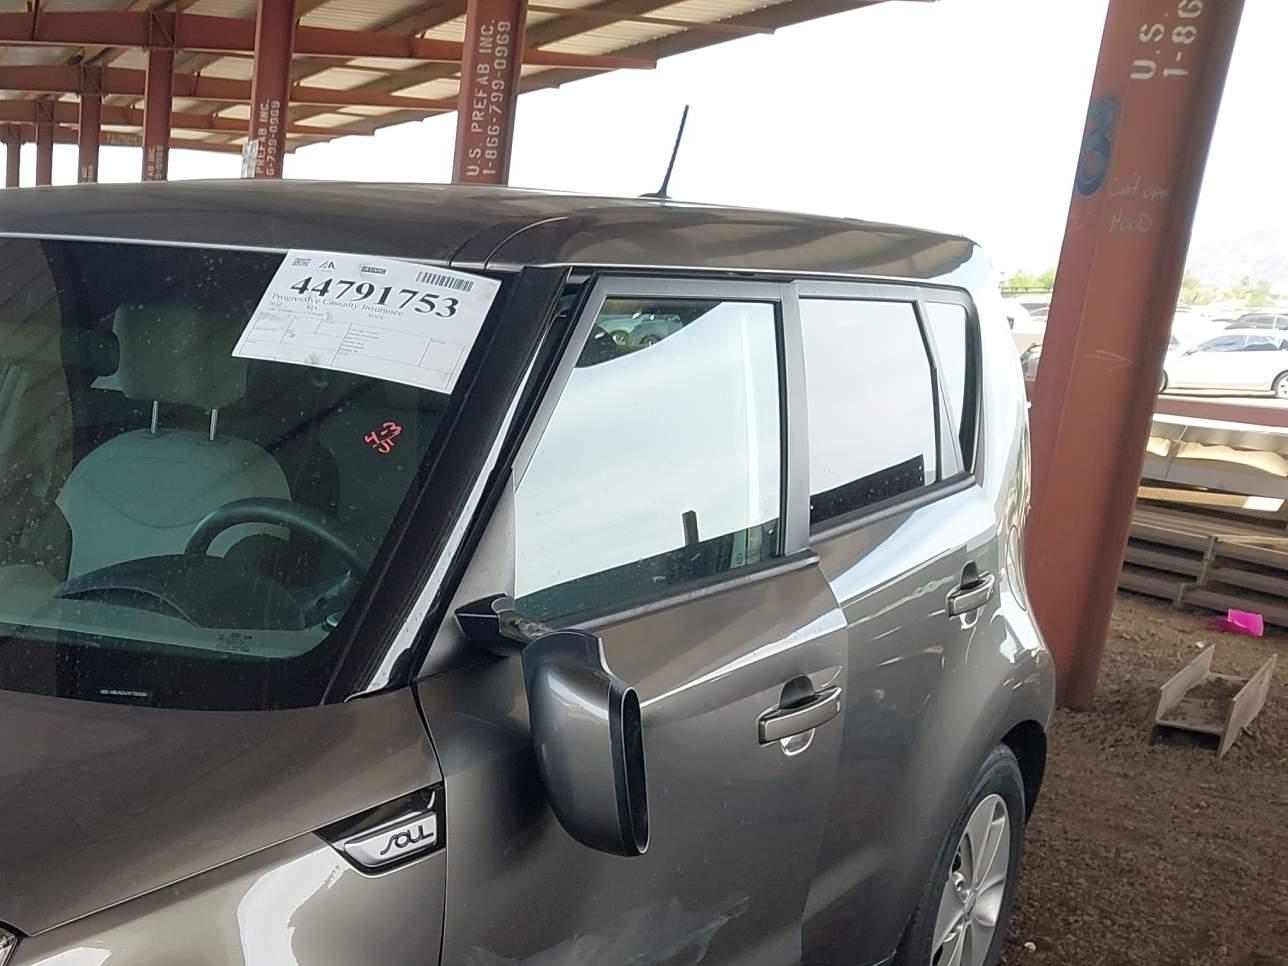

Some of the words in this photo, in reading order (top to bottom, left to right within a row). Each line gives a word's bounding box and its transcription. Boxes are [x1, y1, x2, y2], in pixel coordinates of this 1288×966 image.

[479, 19, 495, 53] INC.
[471, 63, 490, 132] PREFAB
[483, 21, 511, 175] 1-866-799-0969
[272, 293, 321, 305] Progressive
[322, 299, 357, 310] Casualty
[360, 303, 404, 317] Insurance
[290, 276, 460, 318] 44791753
